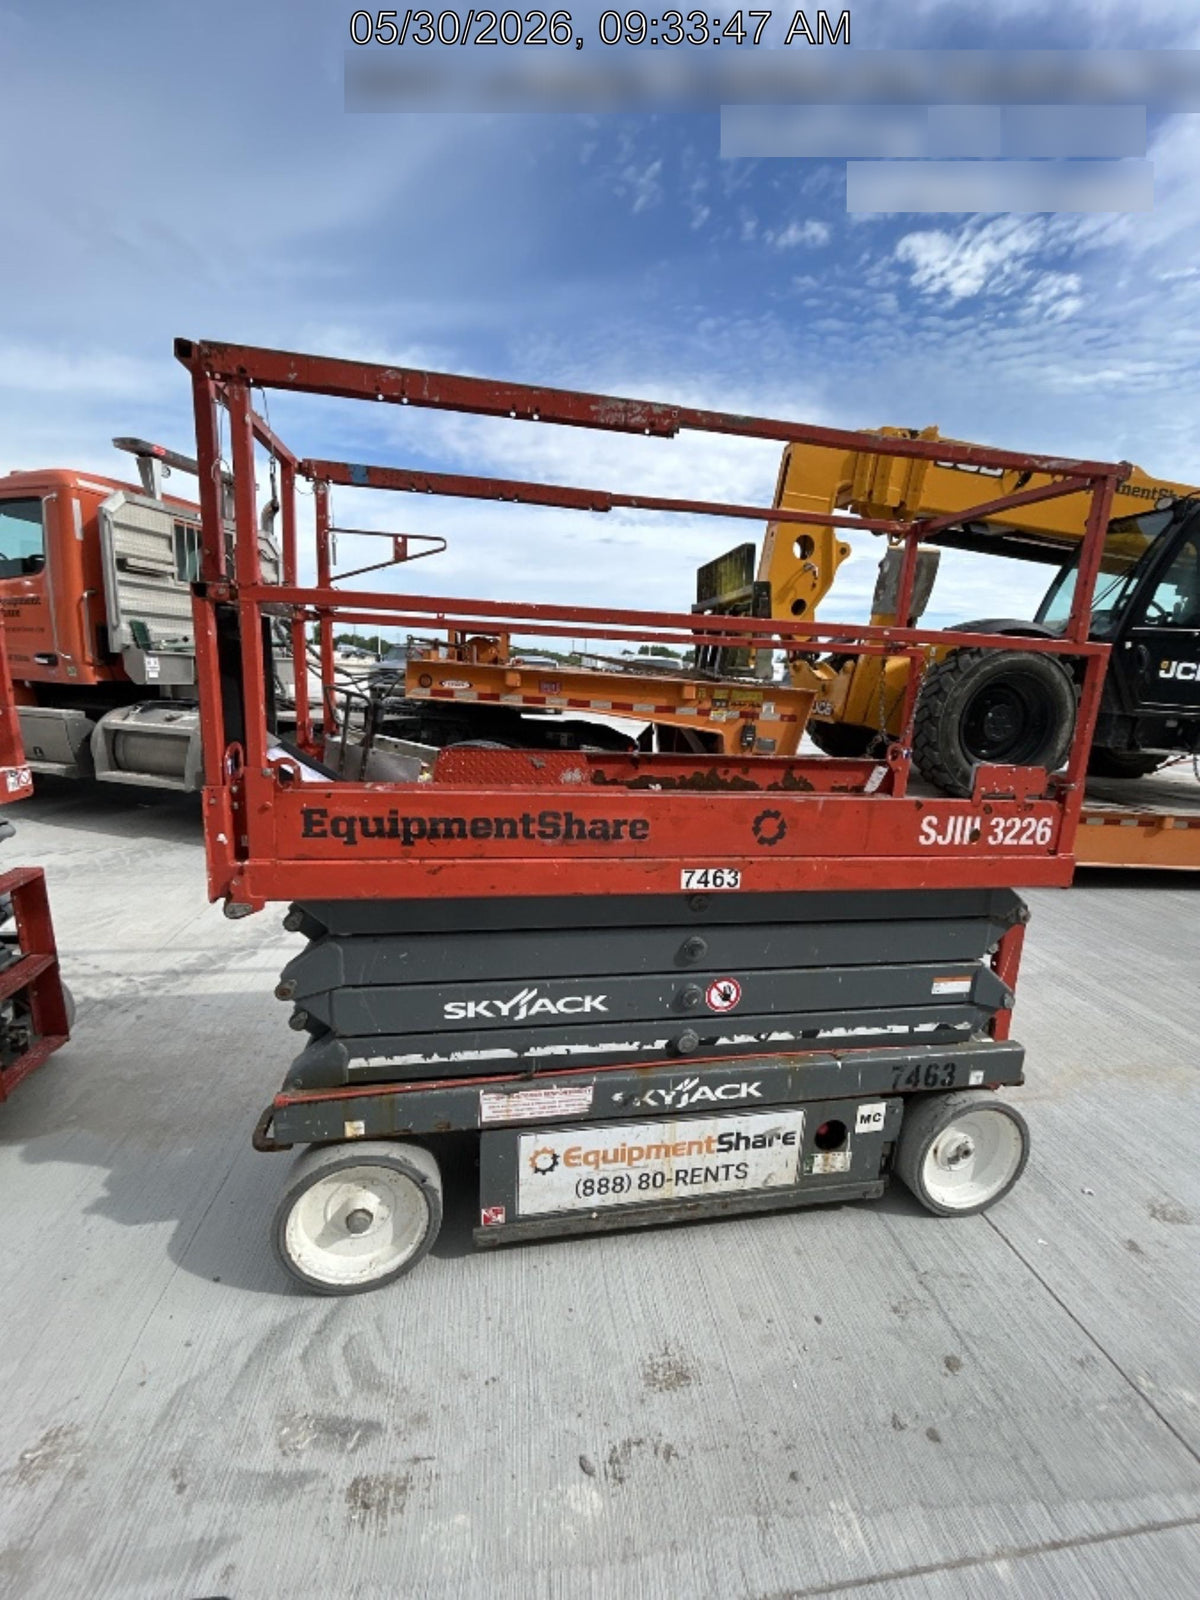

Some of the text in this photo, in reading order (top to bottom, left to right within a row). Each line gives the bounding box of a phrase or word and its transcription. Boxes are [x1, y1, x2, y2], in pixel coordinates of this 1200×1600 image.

[1158, 659, 1200, 682] JC
[301, 808, 651, 846] EquipmentShare
[987, 816, 1054, 846] 3226
[683, 869, 740, 889] 7463
[443, 988, 609, 1021] SKYJACK
[890, 1062, 957, 1091] 7463
[611, 1077, 763, 1109] KYJACK
[859, 1112, 882, 1125] MC
[562, 1129, 797, 1170] EquipmentShare
[575, 1162, 749, 1199] (888) 80-RENTS
